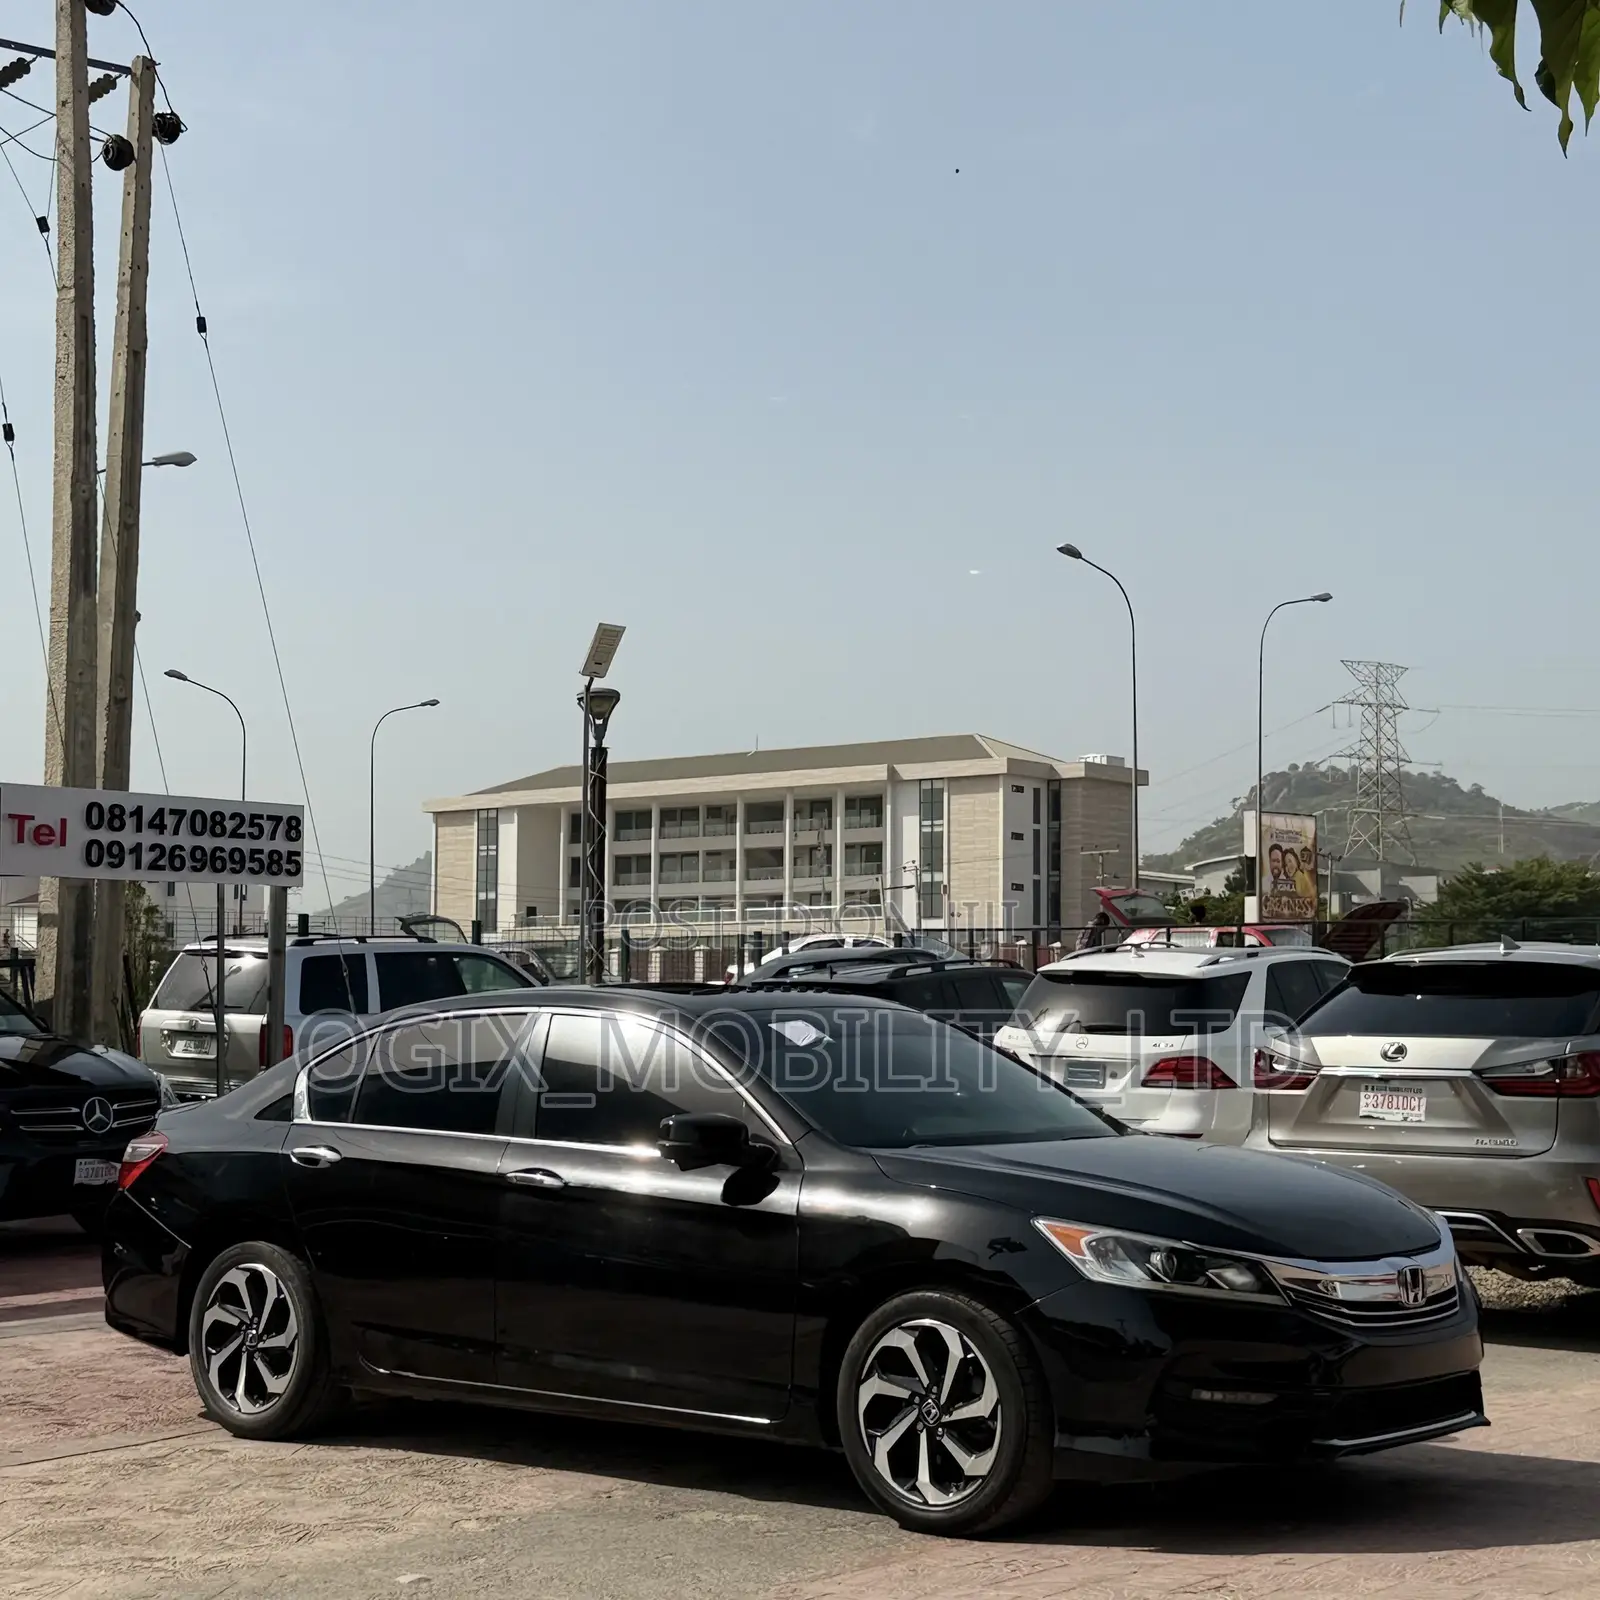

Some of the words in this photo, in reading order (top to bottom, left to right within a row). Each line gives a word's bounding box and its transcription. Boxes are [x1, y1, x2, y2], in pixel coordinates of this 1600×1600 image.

[8, 813, 68, 848] Tel
[85, 801, 303, 843] 08147082578
[85, 838, 302, 877] 09126969585
